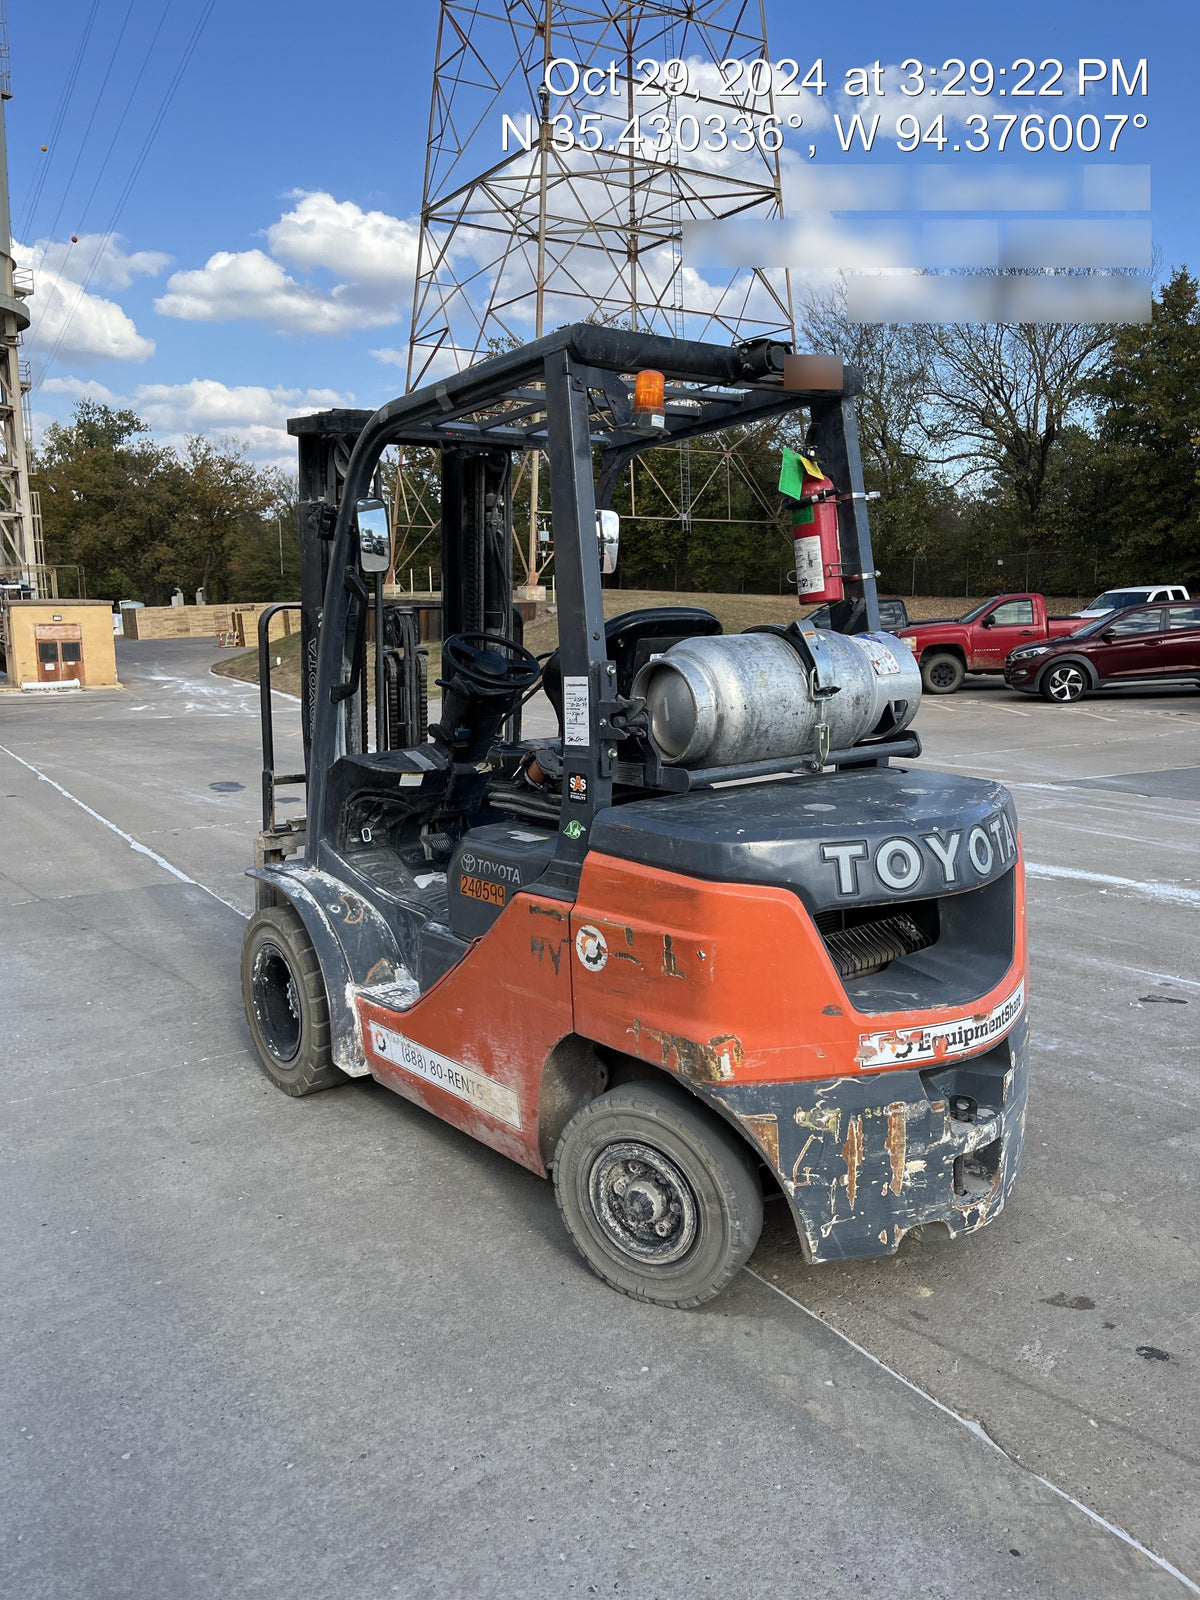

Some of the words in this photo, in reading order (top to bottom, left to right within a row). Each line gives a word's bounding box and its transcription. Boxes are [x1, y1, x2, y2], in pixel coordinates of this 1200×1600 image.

[570, 775, 587, 792] SAS
[821, 809, 1018, 895] TOYOTA
[477, 858, 521, 885] TOYOTA
[461, 876, 505, 905] 240599
[401, 1044, 427, 1073] (888)
